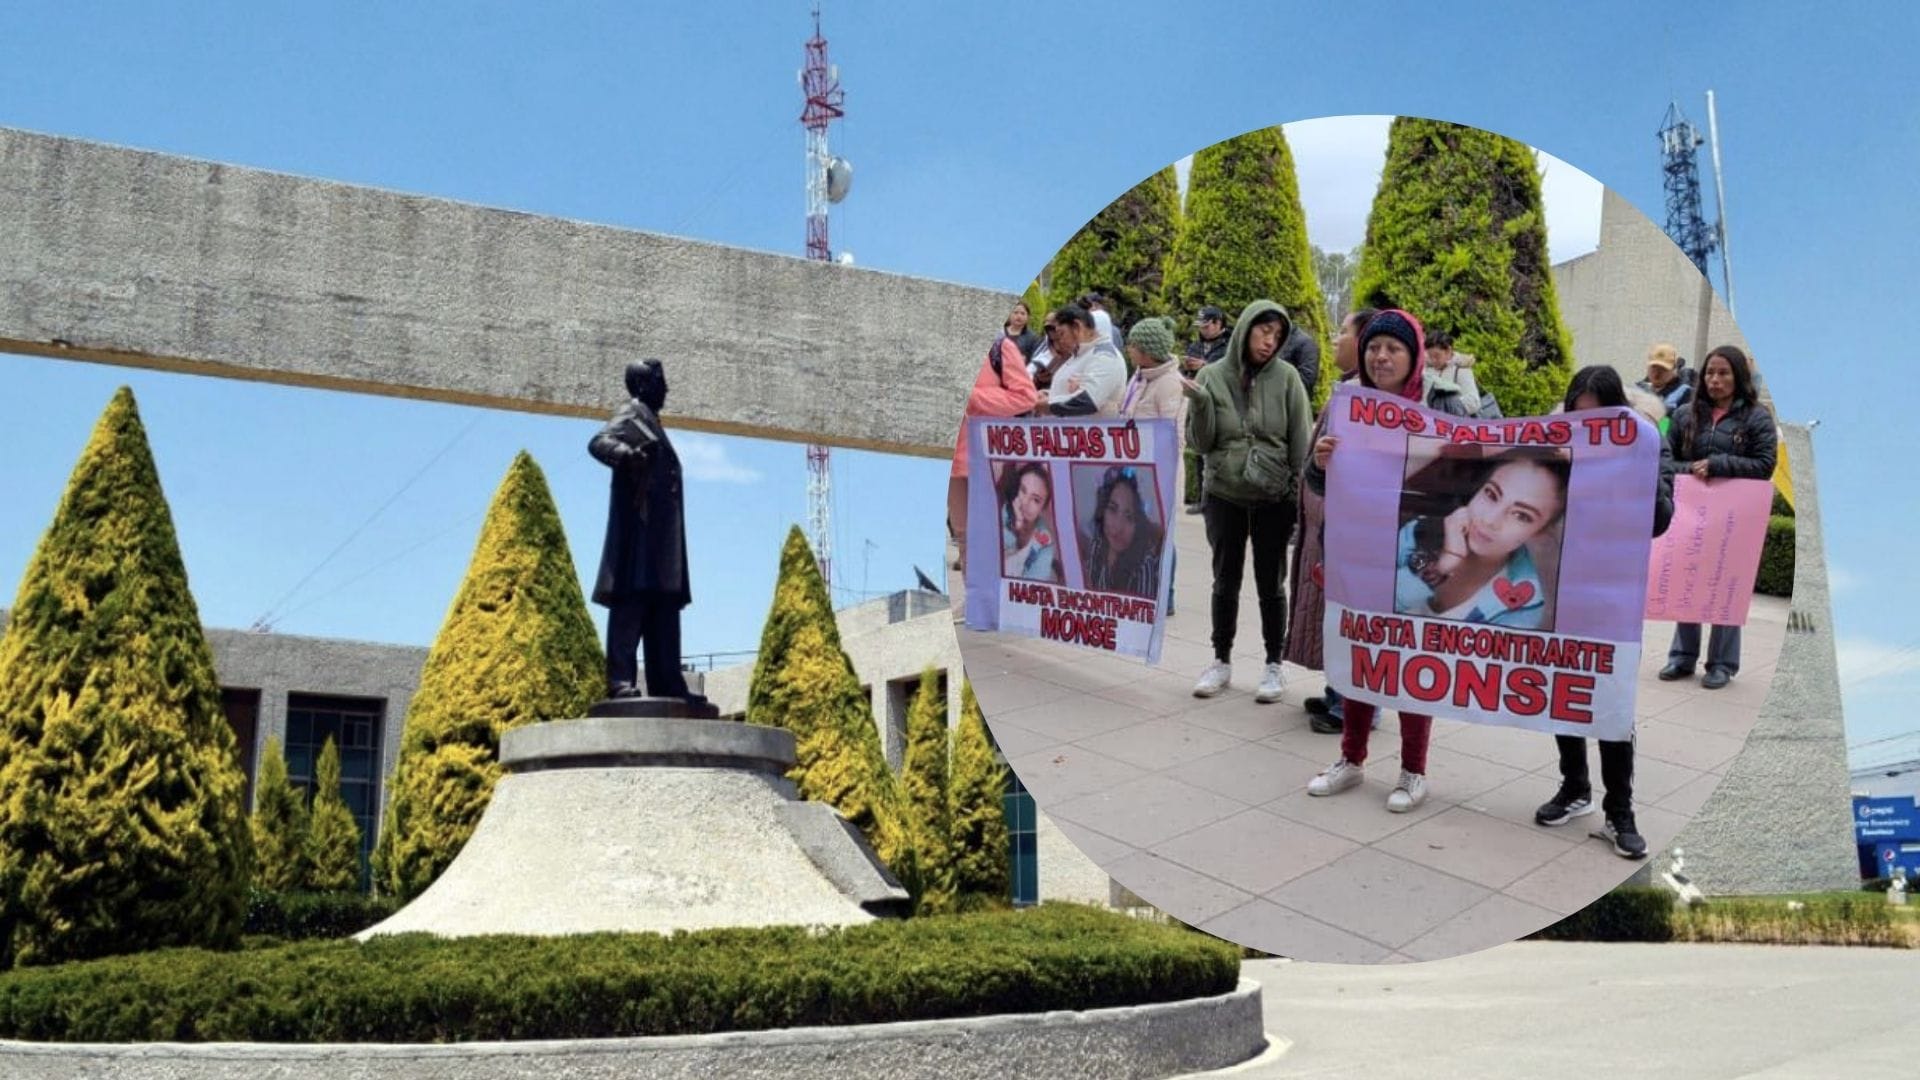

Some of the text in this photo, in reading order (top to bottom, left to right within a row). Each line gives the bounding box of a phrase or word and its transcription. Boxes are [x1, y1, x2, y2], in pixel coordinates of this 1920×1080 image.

[987, 418, 1140, 460] NOS FALTAS TÚ
[1350, 396, 1638, 446] NOS FALTAS TÚ
[1009, 581, 1156, 625] HASTA ENCONTRARTE
[1041, 608, 1118, 650] MONSE
[1340, 608, 1615, 674] HASTA ENCONTRARTE
[1351, 644, 1597, 723] MONSE
